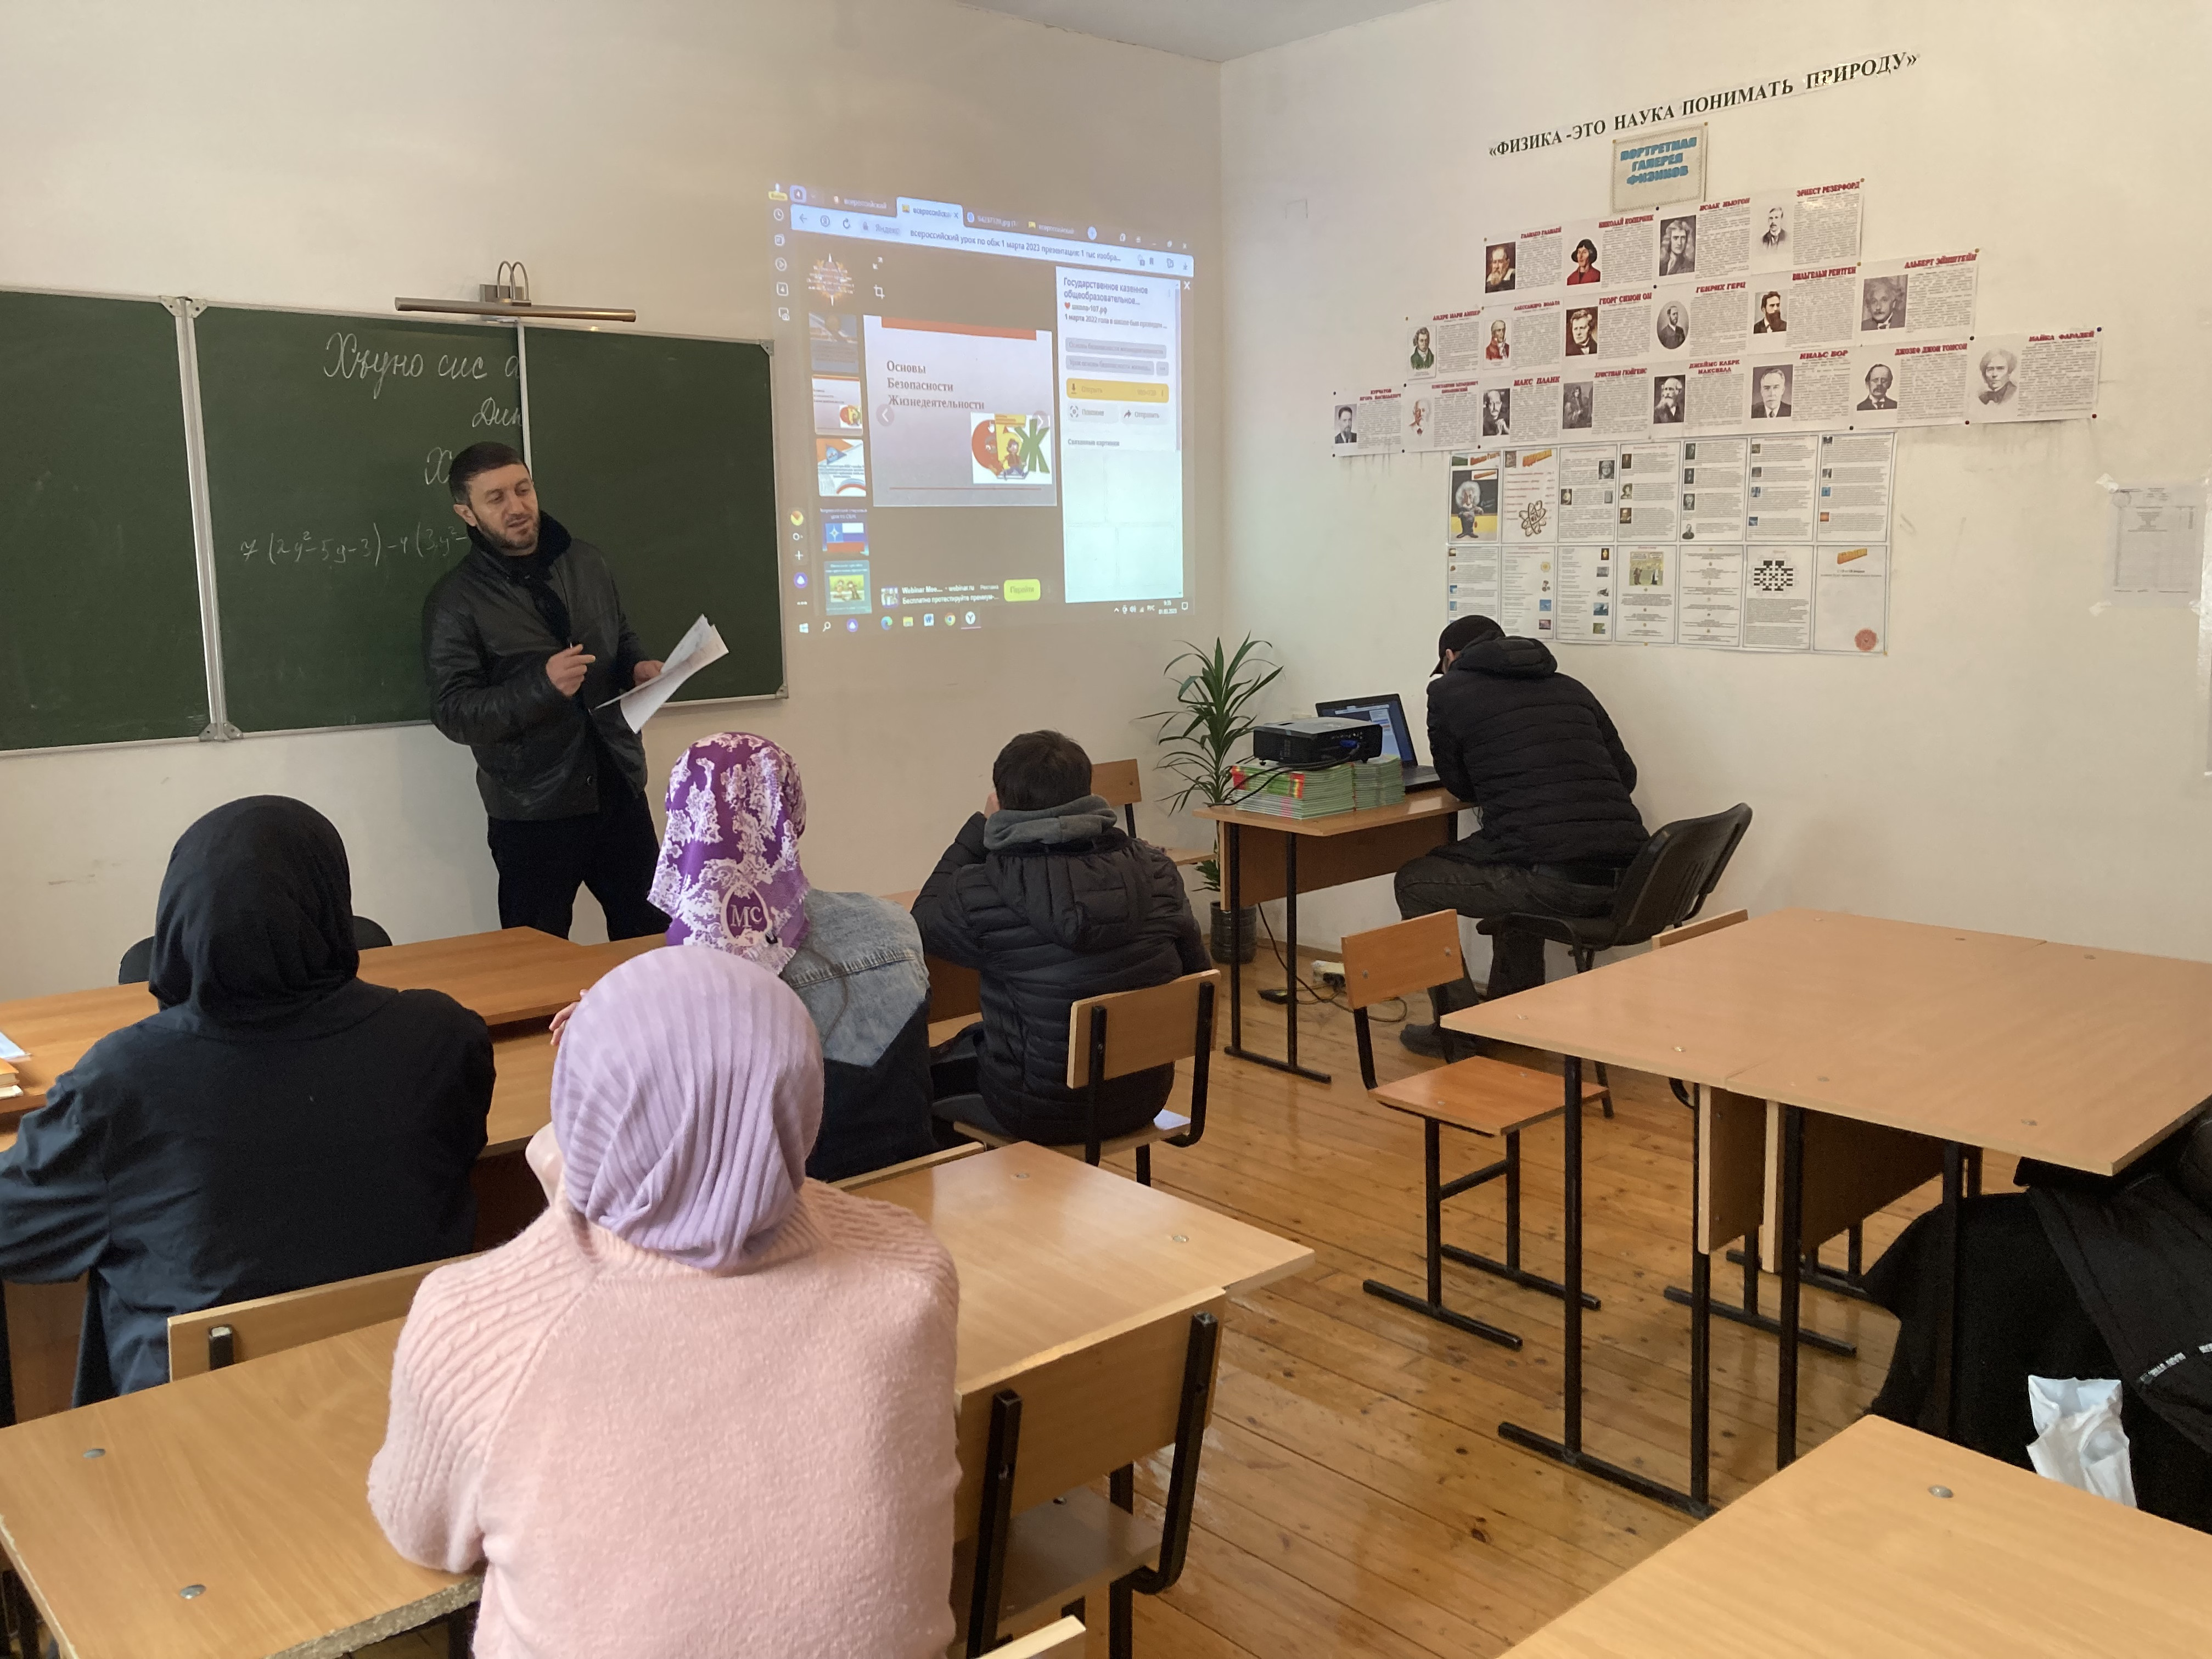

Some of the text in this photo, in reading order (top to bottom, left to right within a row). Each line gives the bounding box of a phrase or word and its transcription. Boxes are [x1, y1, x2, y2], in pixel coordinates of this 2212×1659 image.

[1489, 130, 1562, 156] «ФИЗИКА
[1614, 105, 1675, 131] НАУКА
[1682, 79, 1794, 116] ПОНИМАТЬ
[1805, 52, 1917, 89] ПРИРОДУ»
[1620, 136, 1697, 161] ПОРТРЕТНАЯ
[1631, 152, 1683, 172] ГАЛЕРЕЯ
[1626, 165, 1688, 186] ФИЗИКОВ
[1822, 181, 1861, 193] РЕЗЕРФОРД
[875, 223, 900, 235] Яндекс
[910, 229, 959, 242] всероссийский
[960, 236, 976, 245] урок
[1006, 242, 1025, 251] марта
[1025, 242, 1041, 252] 2023
[1904, 253, 1977, 269] АЛЬБЕРТ ЭЙНШТЕЙН
[1063, 277, 1148, 294] Государственное казенное
[1696, 281, 1746, 293] ГЕНРИХ ГЕРЦ
[1599, 292, 1652, 305] ГЕОРГ СИМОН ОМ
[2058, 330, 2095, 340] ФАРАДЕЙ
[1799, 349, 1849, 360] НИЛЬС БОР
[886, 360, 926, 374] Основы
[1688, 358, 1741, 369] ДЖЕЙМС КЛЕРК
[1698, 367, 1732, 375] МАКСВЕЛЛ
[886, 377, 954, 392] Безопасности
[1513, 375, 1560, 386] МАКС ПЛАНК
[887, 394, 985, 410] Жизнедеятельности
